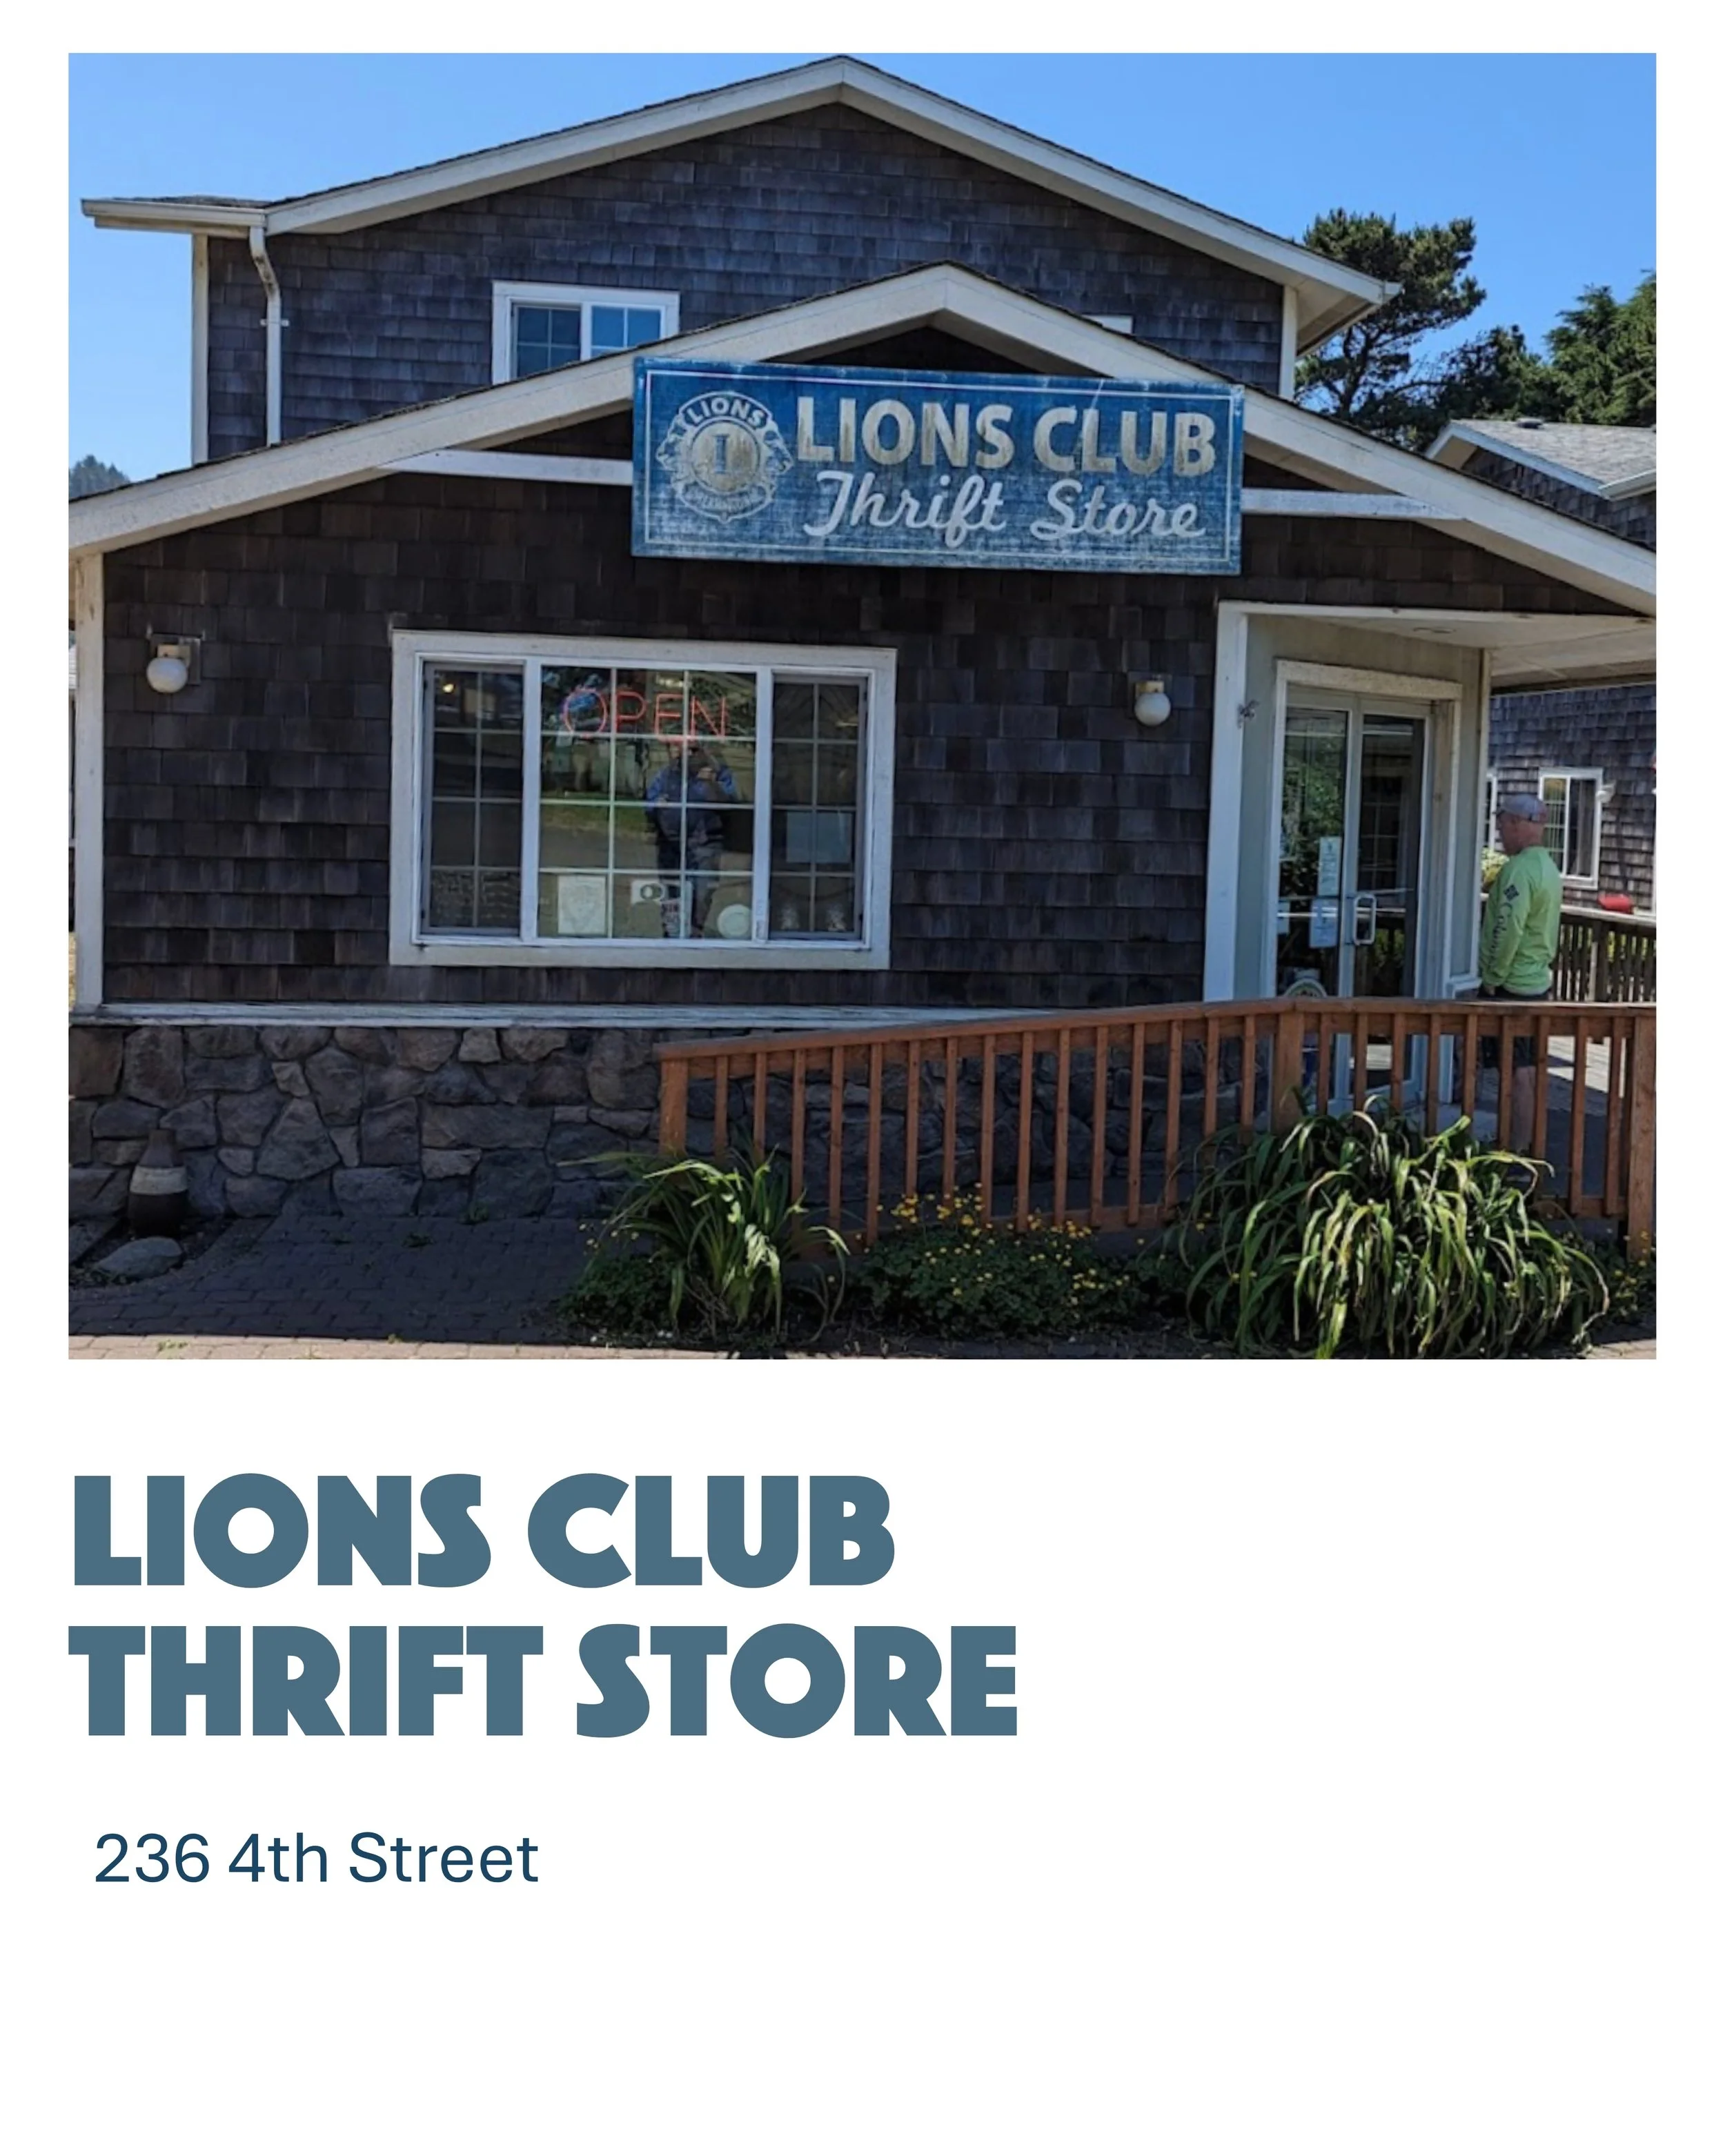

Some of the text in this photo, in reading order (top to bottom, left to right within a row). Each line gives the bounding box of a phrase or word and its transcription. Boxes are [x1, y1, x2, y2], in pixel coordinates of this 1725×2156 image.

[687, 397, 767, 428] LIONS
[797, 396, 1216, 477] LIONS CLUB
[802, 470, 1206, 548] Thrift Store
[564, 688, 727, 744] OPEN
